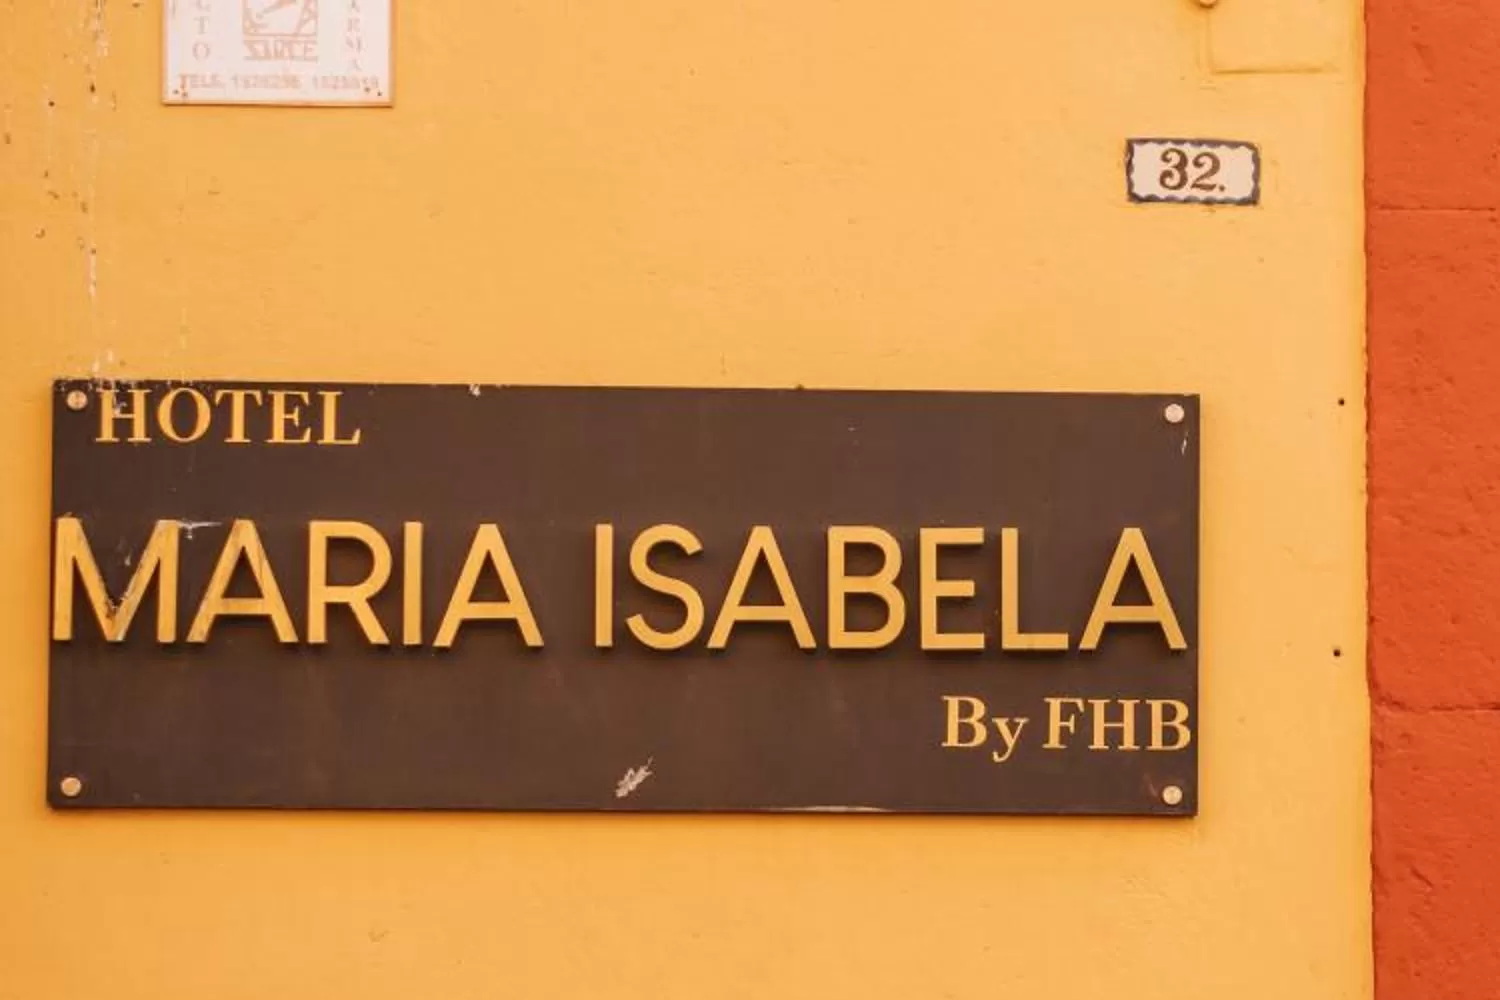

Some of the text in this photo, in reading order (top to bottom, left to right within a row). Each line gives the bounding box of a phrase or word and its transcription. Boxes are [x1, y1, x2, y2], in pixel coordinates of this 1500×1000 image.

[1158, 147, 1226, 192] 32.
[95, 387, 361, 445] HOTEL
[52, 515, 1188, 651] MARIA ISABELA
[941, 695, 1192, 763] By FHB
